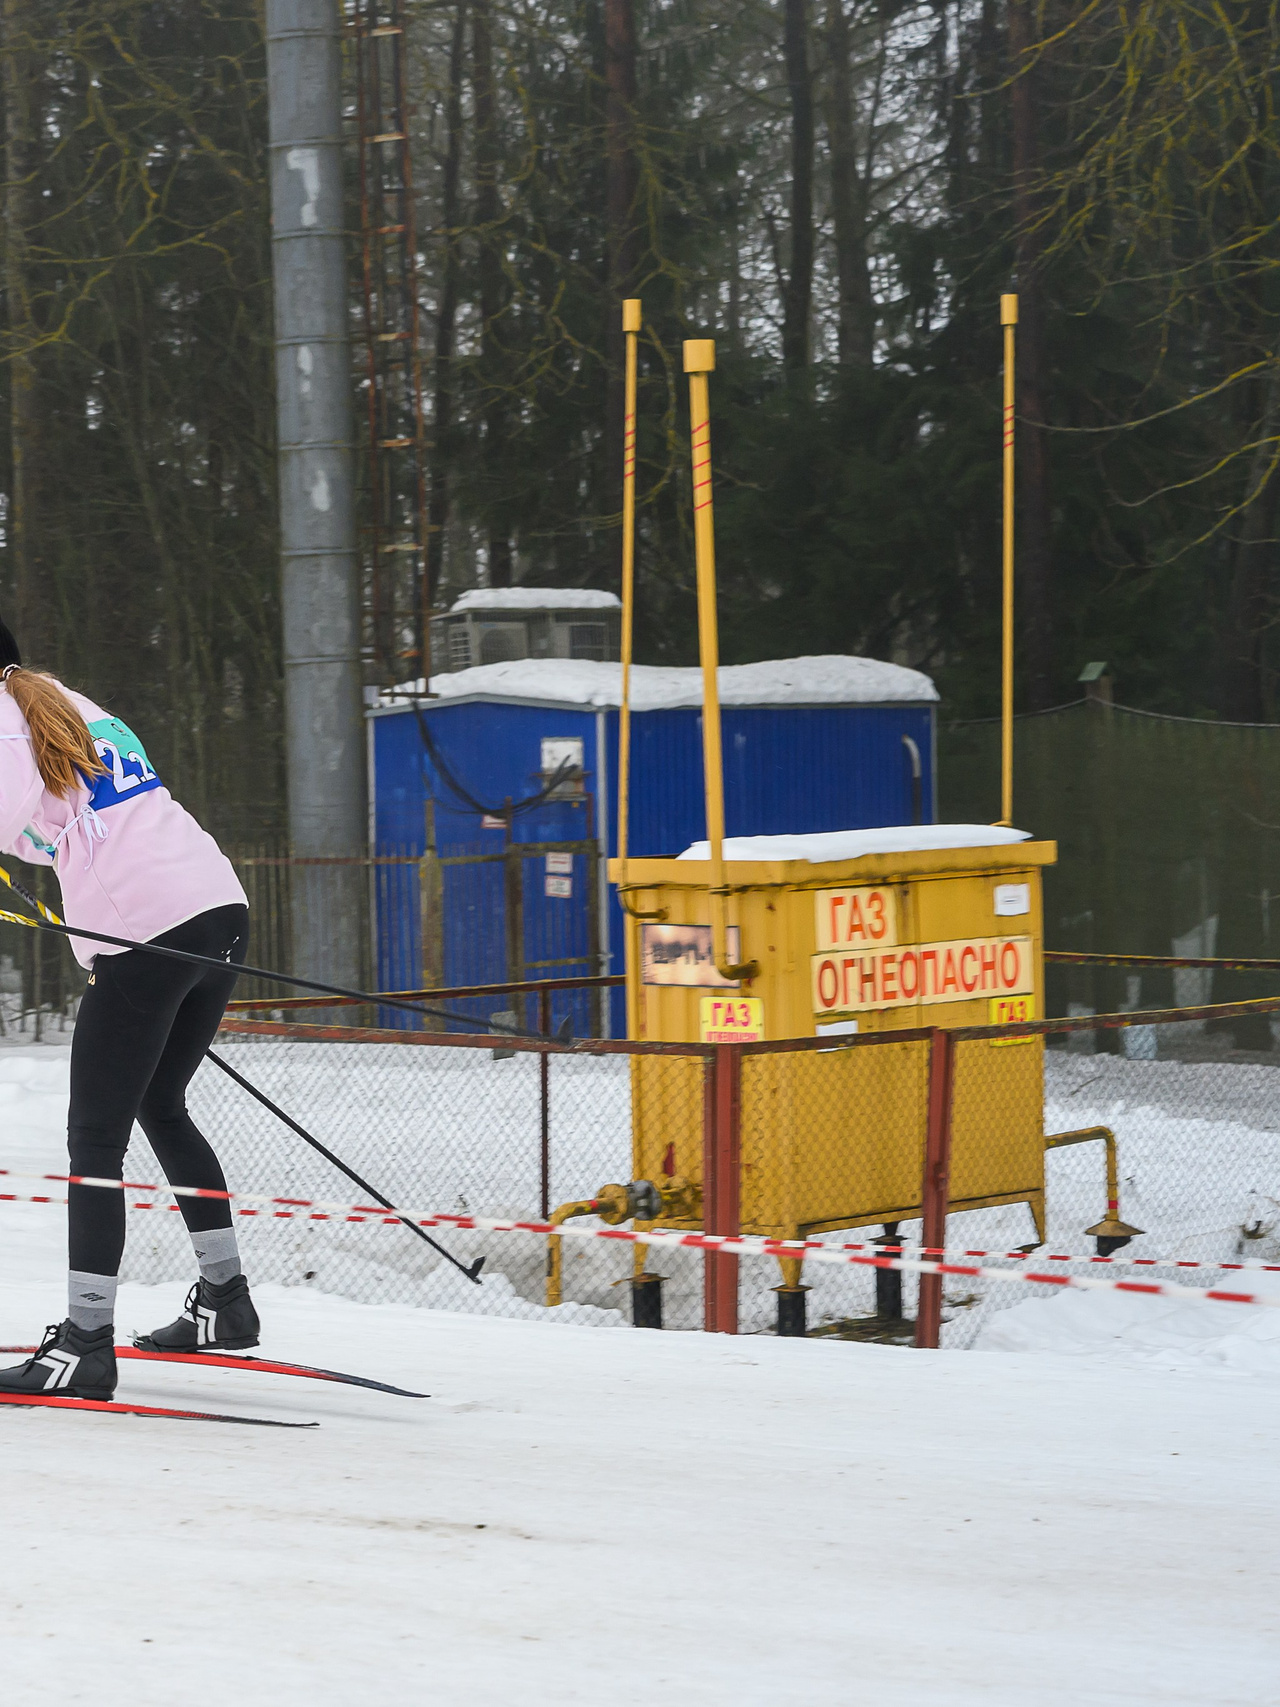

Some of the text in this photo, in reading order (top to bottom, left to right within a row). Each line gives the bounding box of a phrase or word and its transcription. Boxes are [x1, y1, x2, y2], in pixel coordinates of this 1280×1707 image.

[830, 891, 887, 943] ГАЗ
[818, 942, 1019, 1008] ОГНЕОПАСНО
[711, 1002, 751, 1027] ГАЗ
[997, 1001, 1027, 1024] ГАЗ
